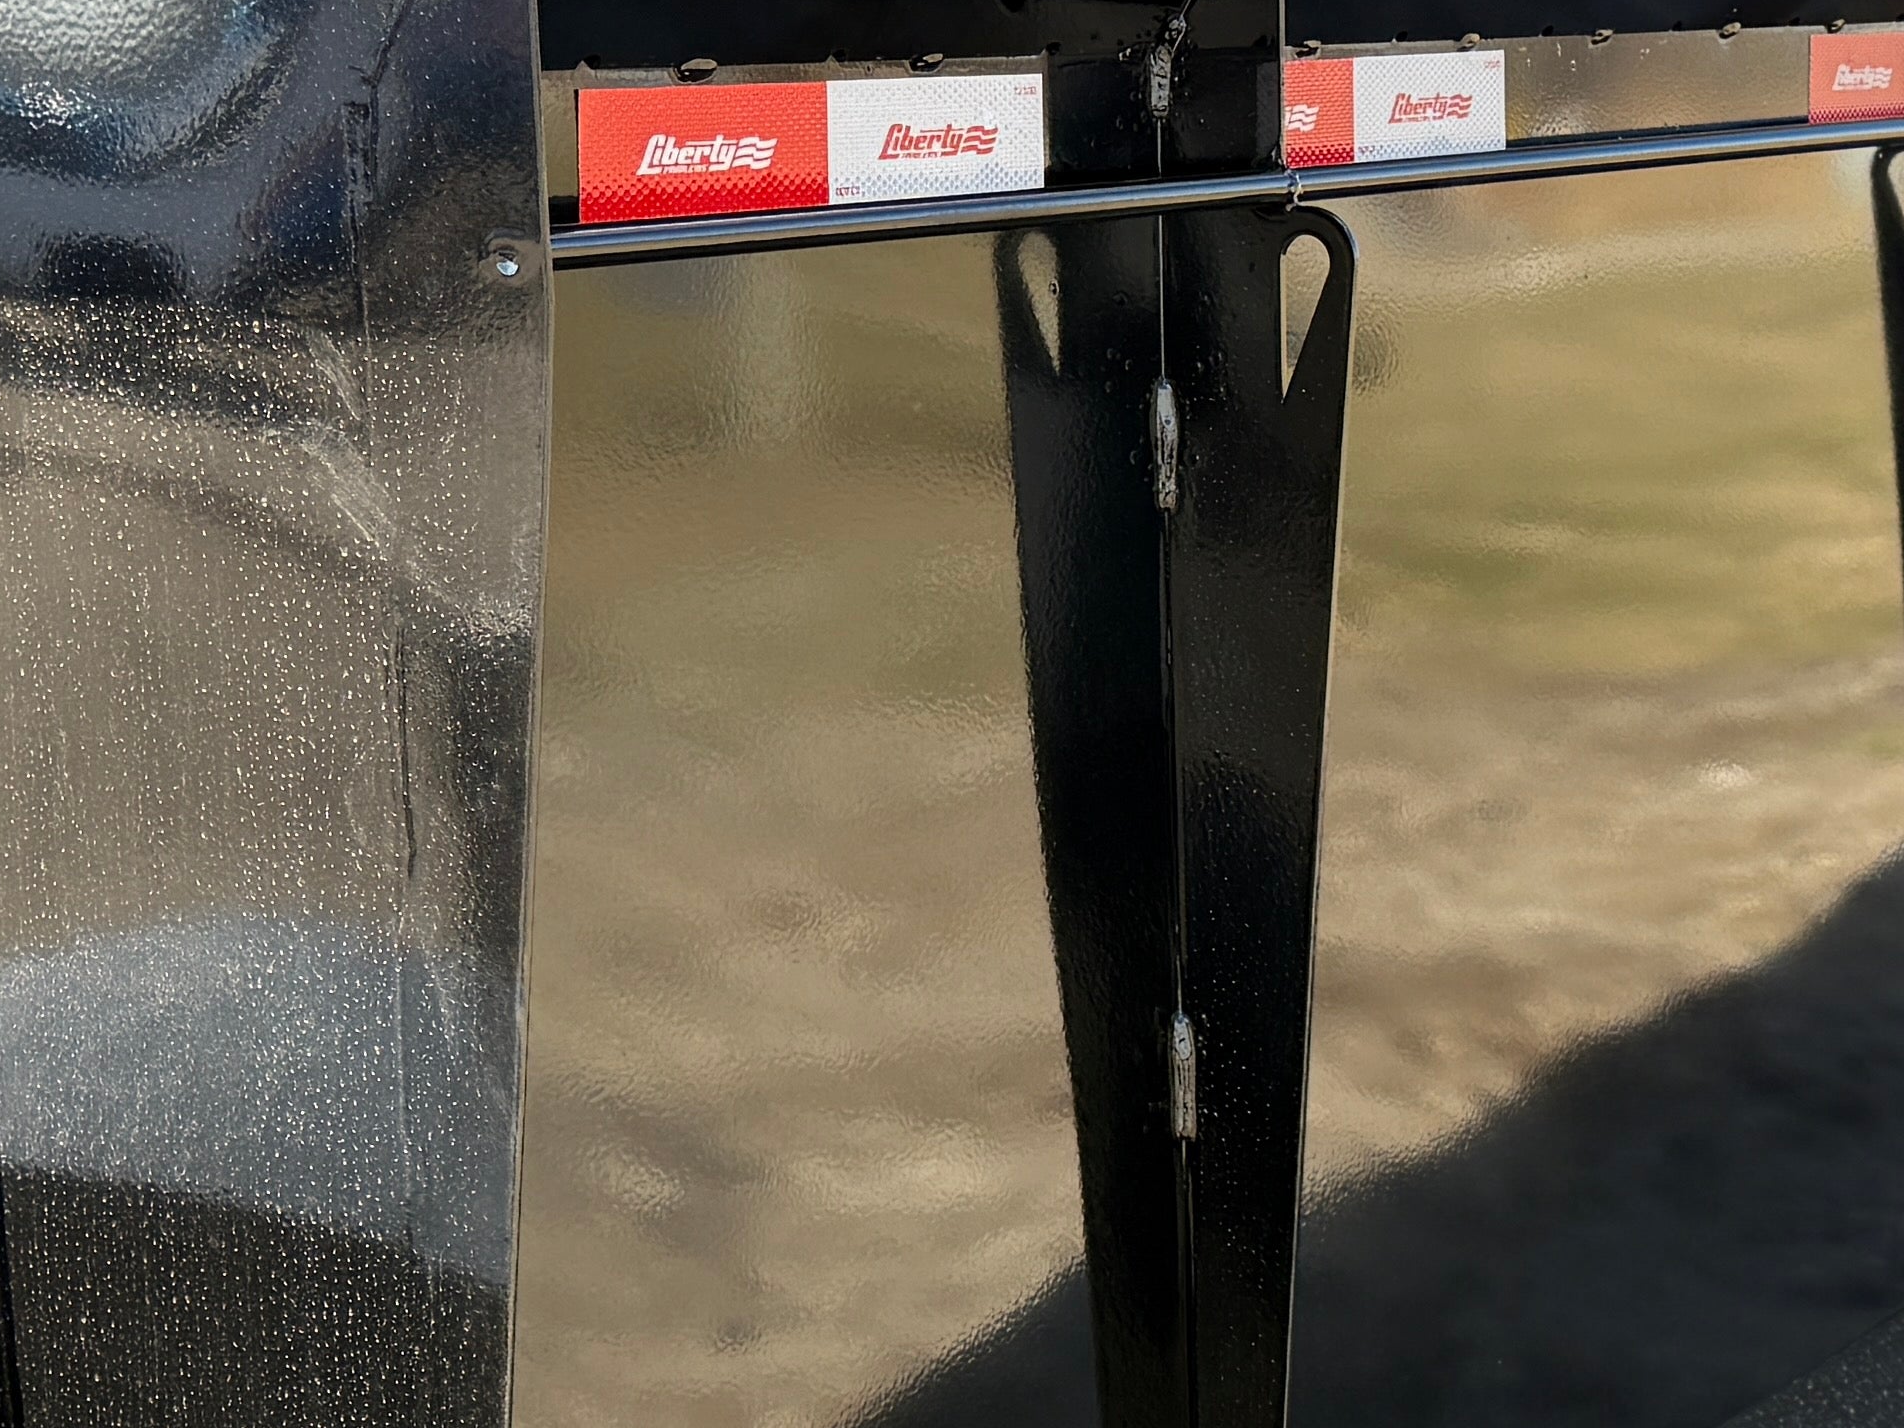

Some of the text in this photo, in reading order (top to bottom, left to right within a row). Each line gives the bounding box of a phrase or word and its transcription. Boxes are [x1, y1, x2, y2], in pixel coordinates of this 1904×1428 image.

[1388, 91, 1448, 124] Liberty
[636, 134, 739, 176] Liberty
[878, 123, 965, 160] Liberty
